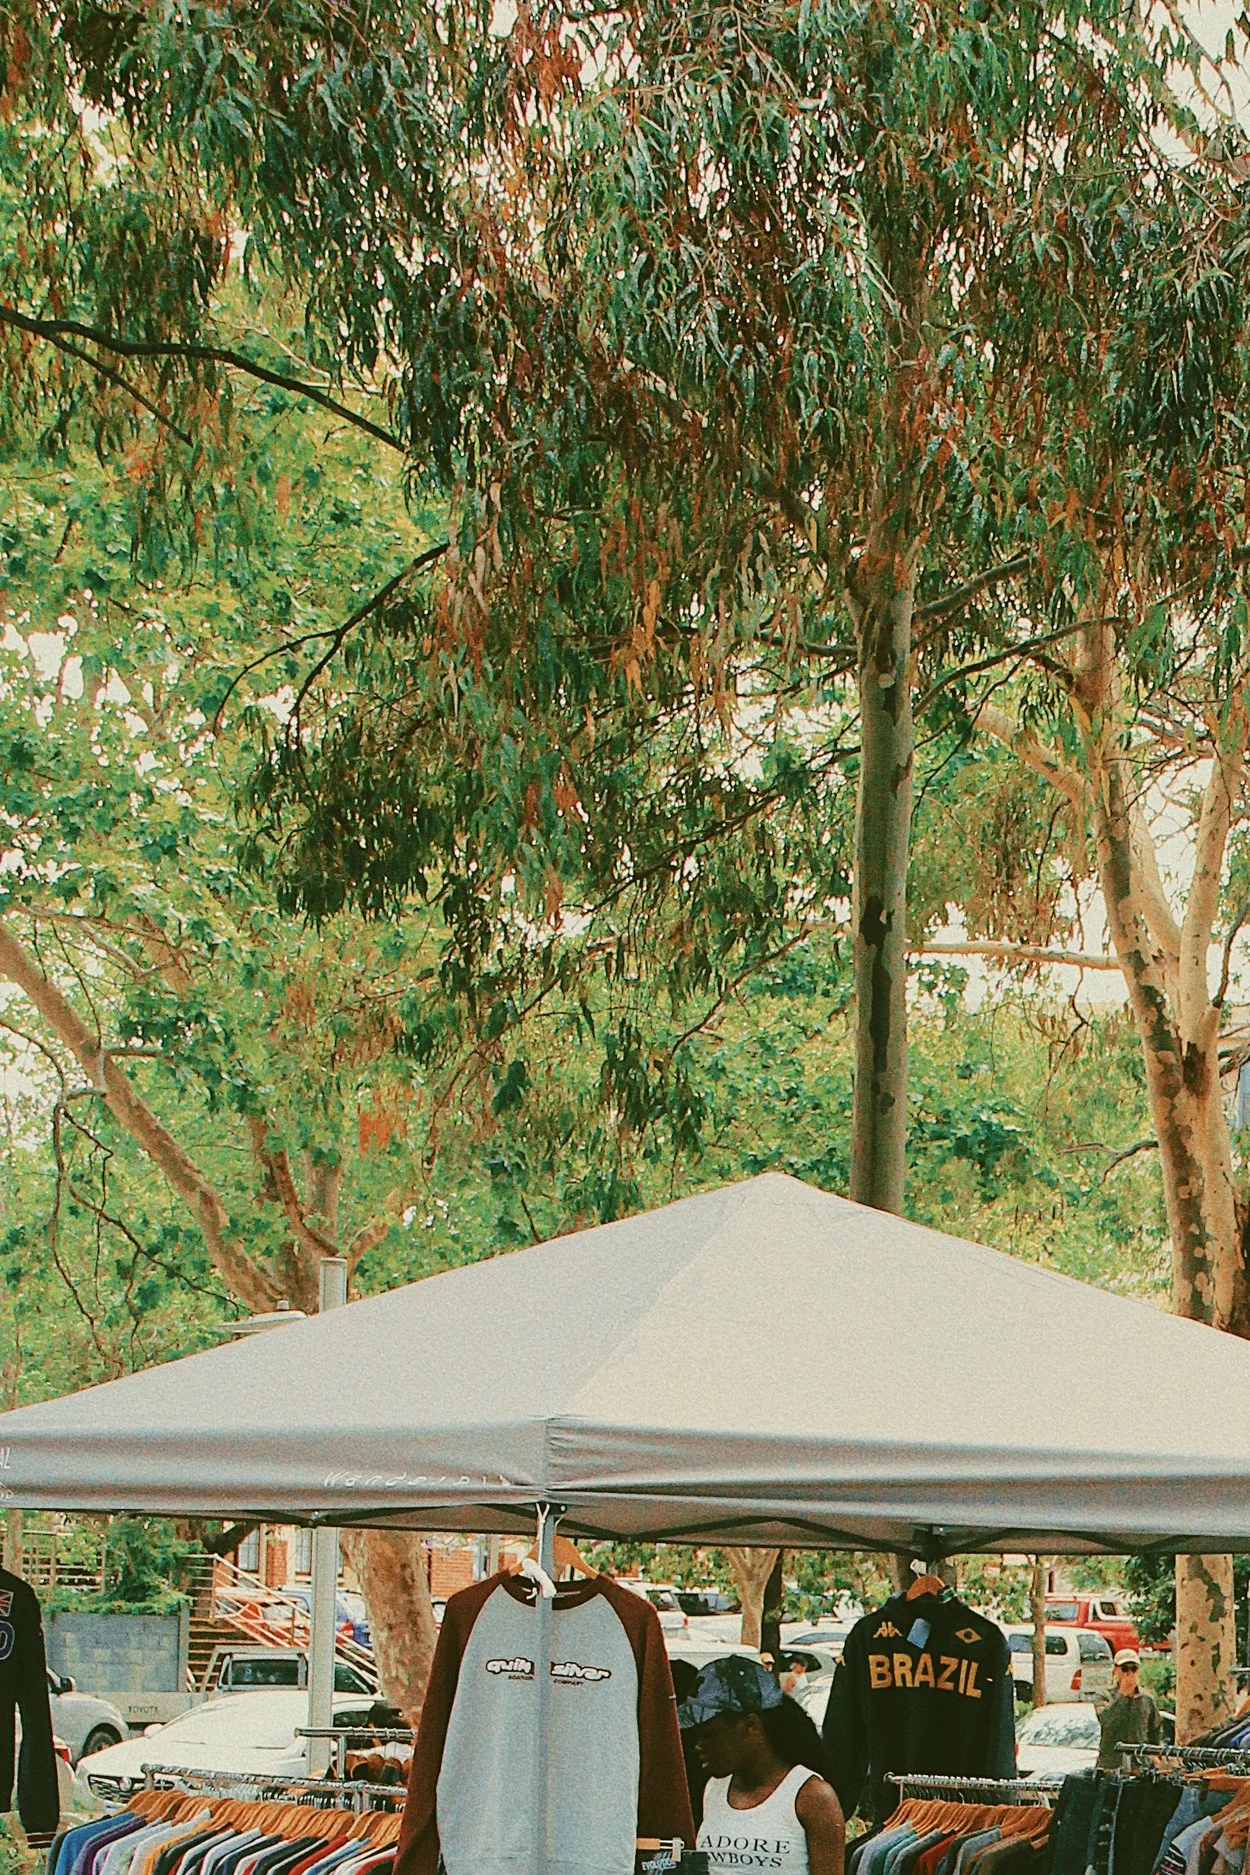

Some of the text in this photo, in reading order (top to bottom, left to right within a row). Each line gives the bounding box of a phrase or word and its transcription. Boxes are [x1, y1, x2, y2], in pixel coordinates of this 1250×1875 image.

[868, 1653, 982, 1698] BRAZIL
[701, 1835, 790, 1854] ADORE
[707, 1851, 783, 1868] WBOYS
